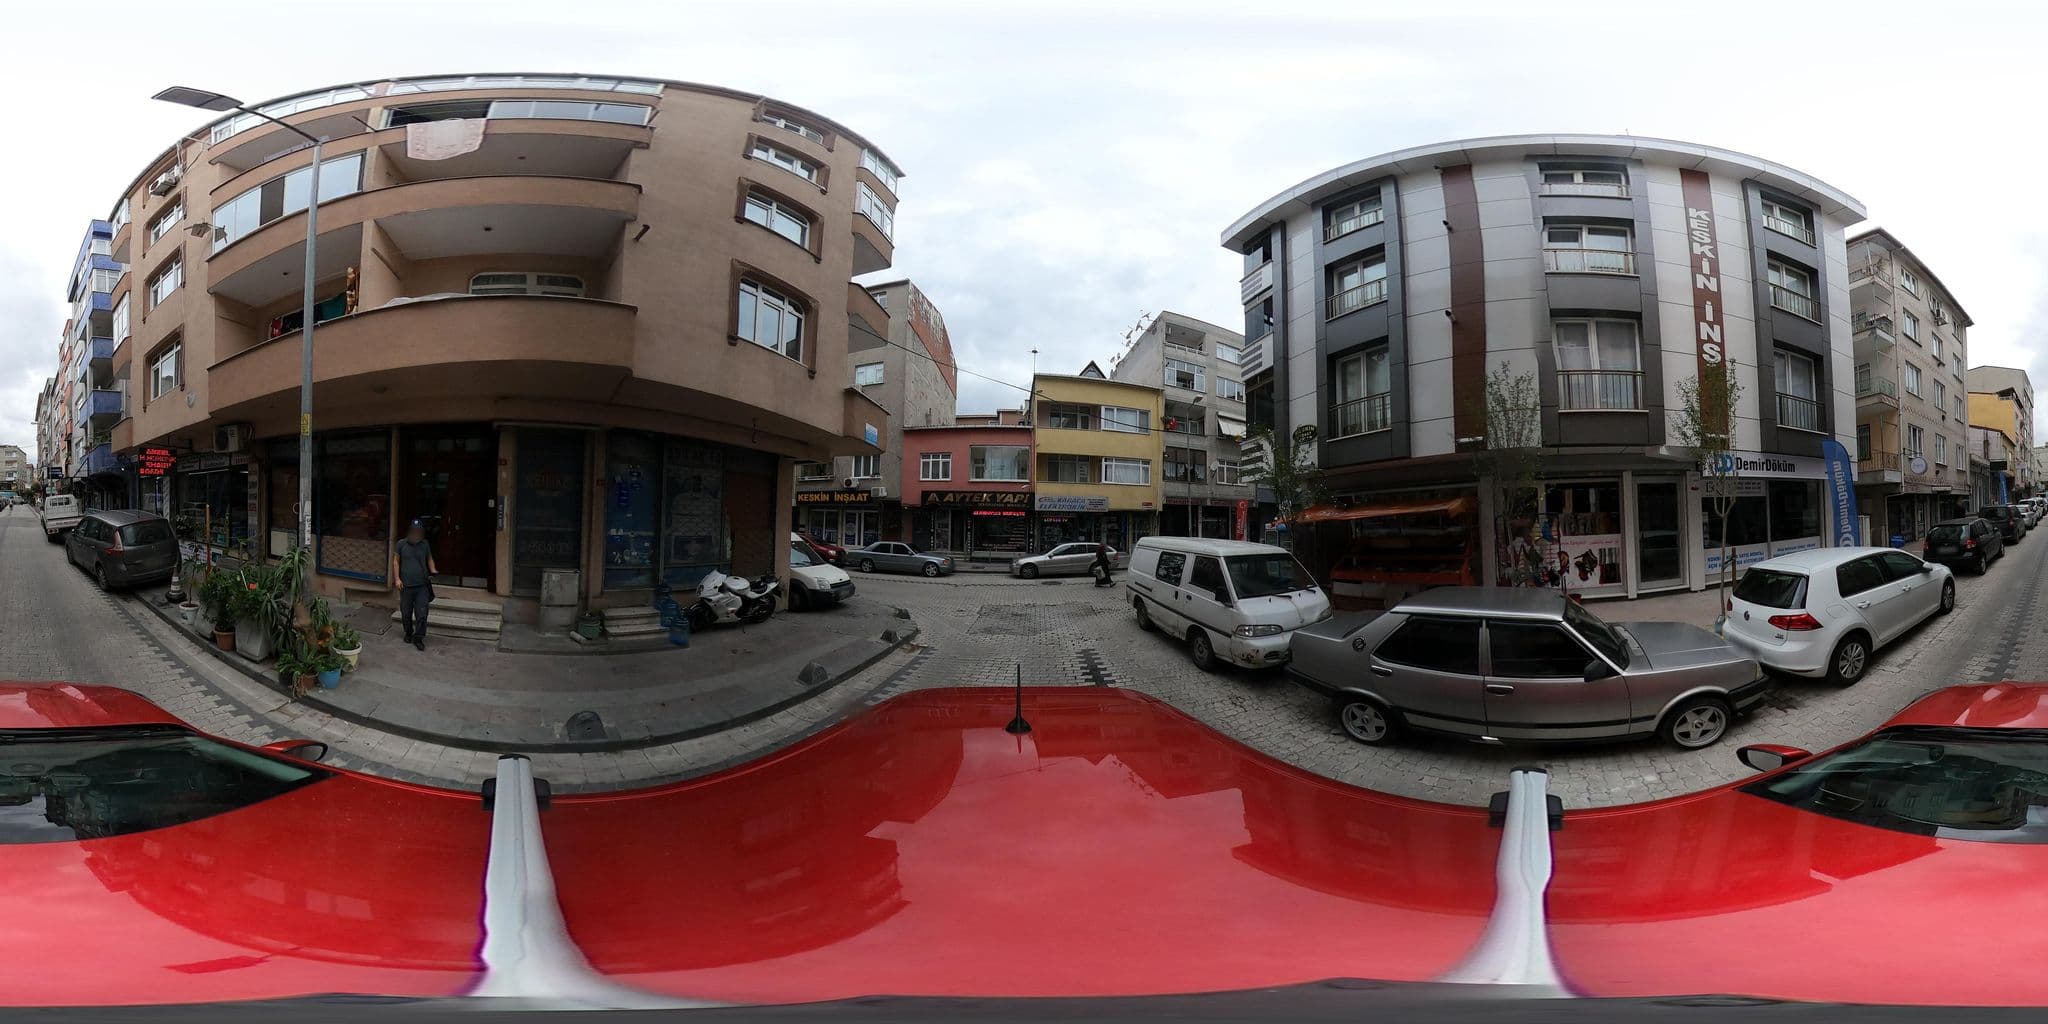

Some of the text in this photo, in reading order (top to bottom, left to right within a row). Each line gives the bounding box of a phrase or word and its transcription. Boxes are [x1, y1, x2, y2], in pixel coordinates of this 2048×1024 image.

[1736, 457, 1796, 473] DemirDöküm
[798, 491, 869, 504] KESKİN İNŞAAT
[943, 493, 993, 503] AYTEK
